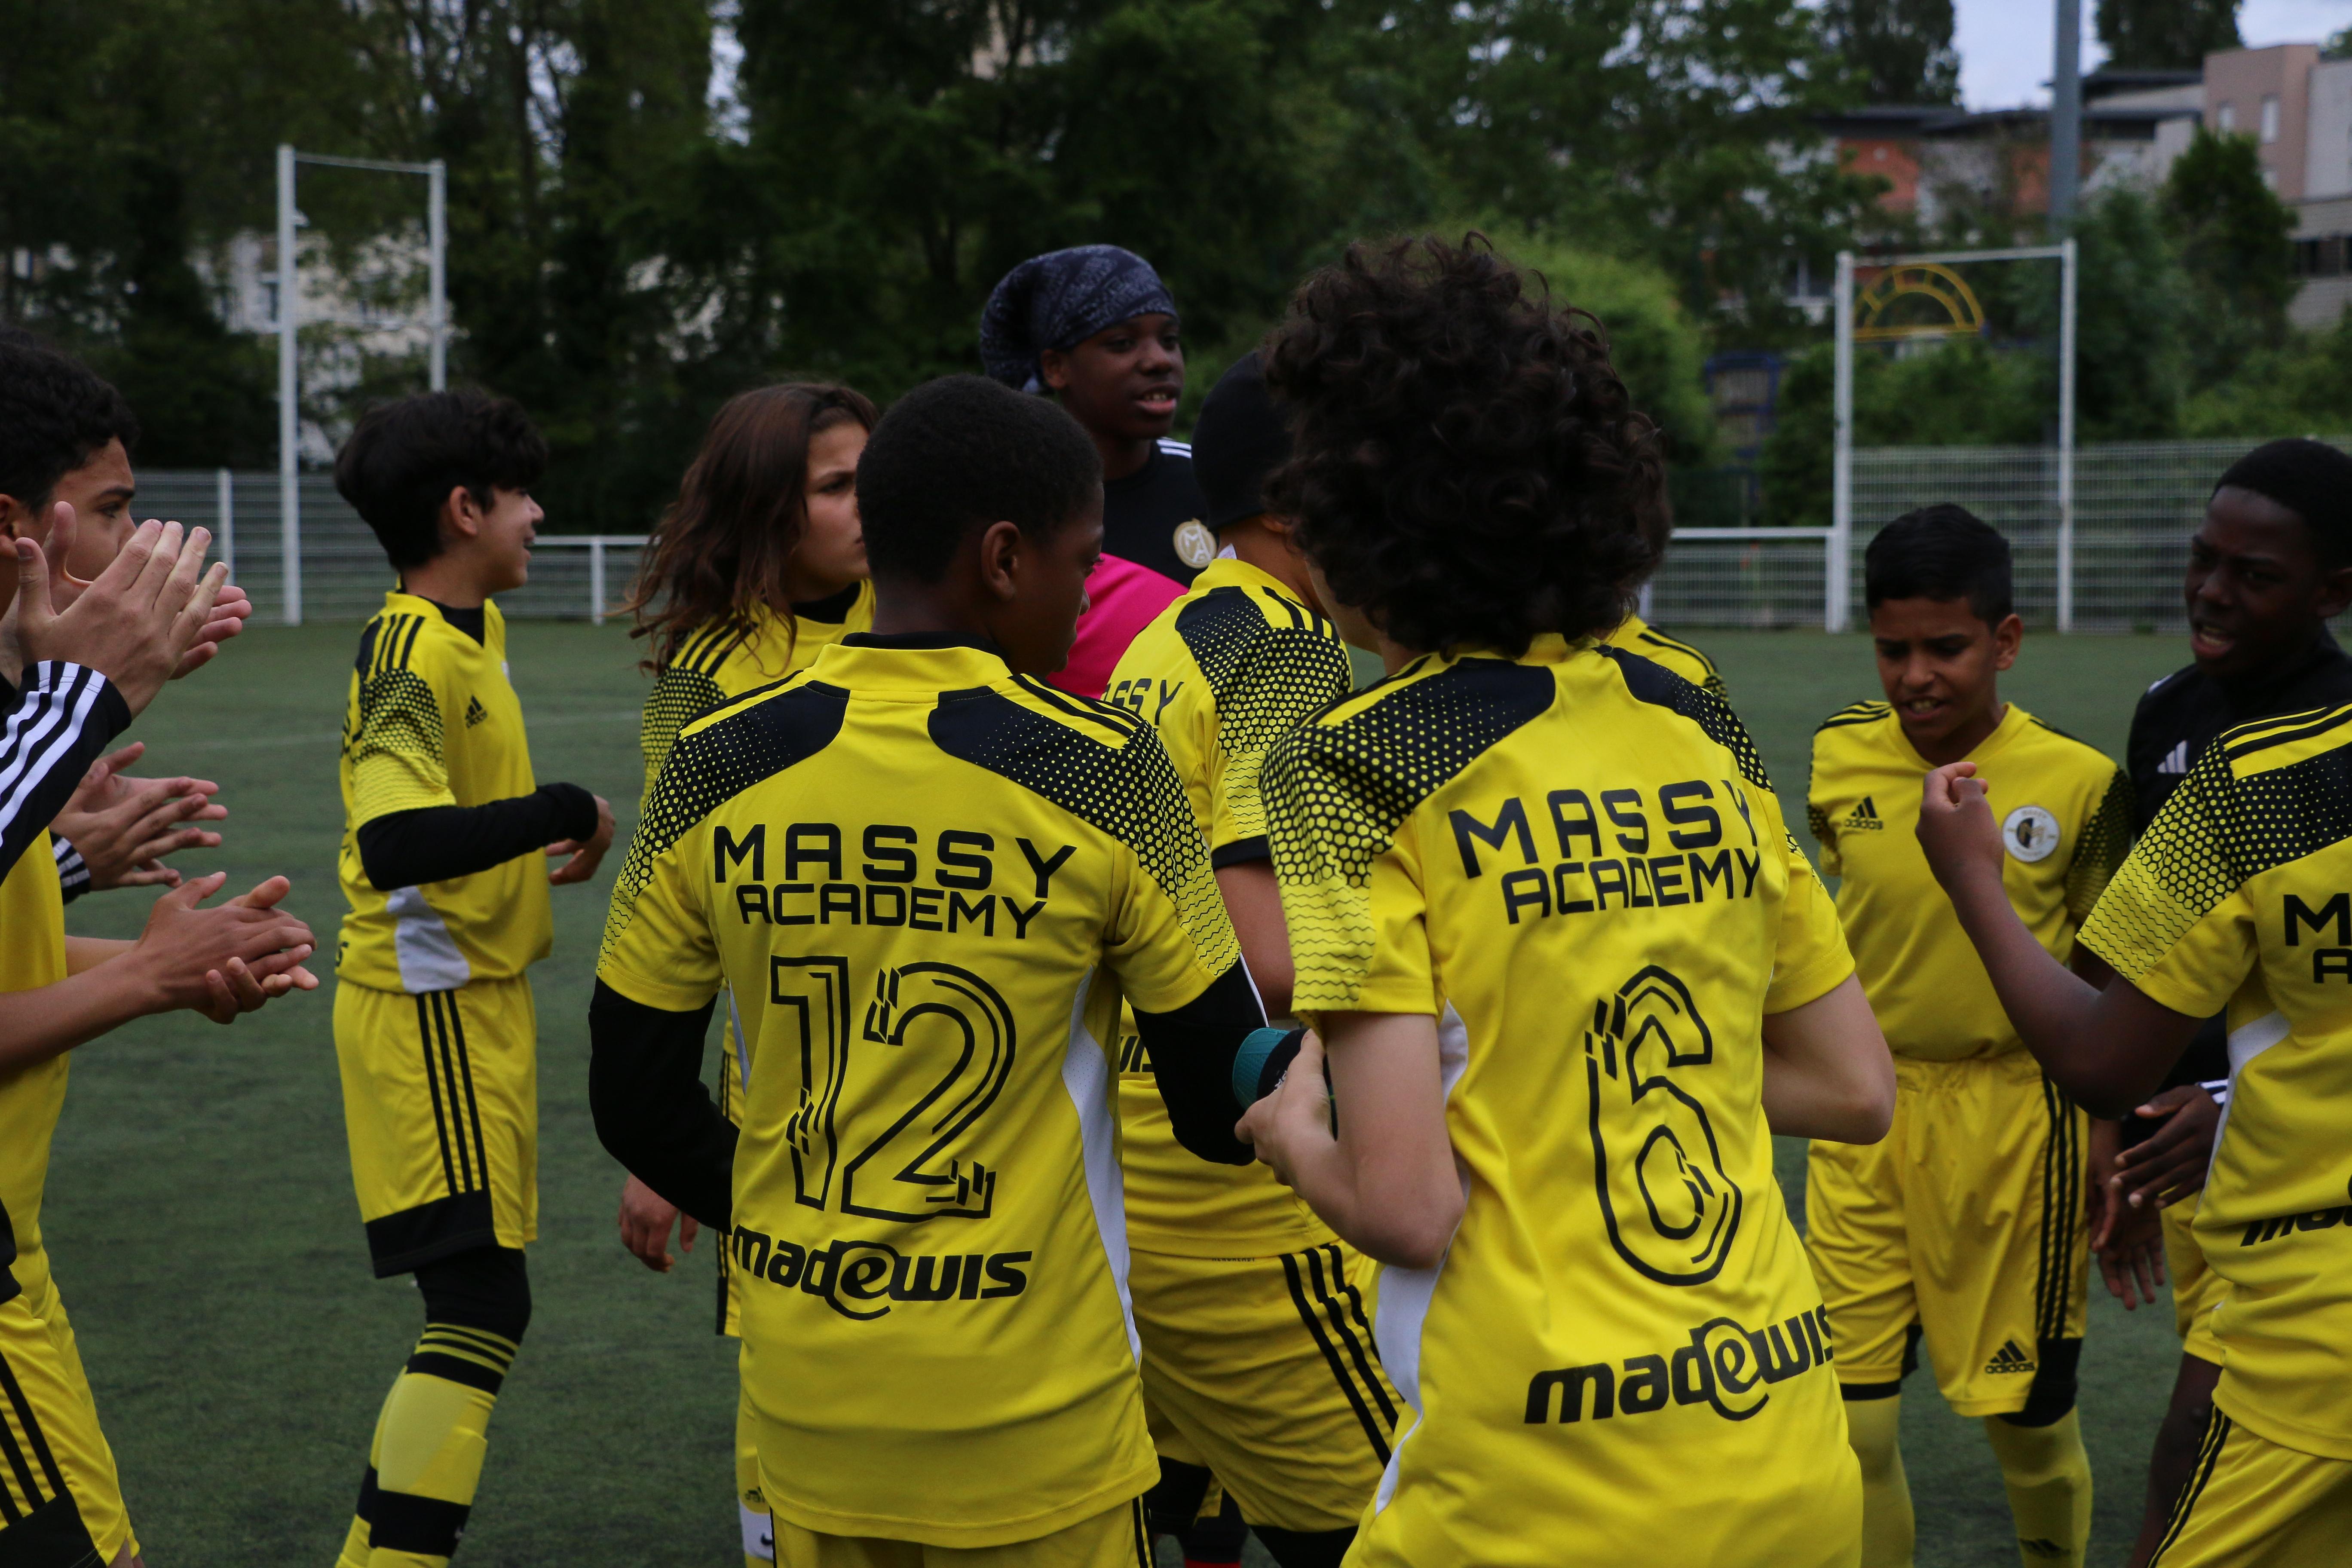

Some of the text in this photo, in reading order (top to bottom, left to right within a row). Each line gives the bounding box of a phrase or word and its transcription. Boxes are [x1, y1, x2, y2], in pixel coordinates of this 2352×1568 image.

[714, 823, 1076, 898] MASSY
[1449, 780, 1758, 879] MASSY
[1844, 817, 1883, 830] adidas
[736, 884, 1046, 939] ACADEMY
[1502, 848, 1760, 924] ACADEMY
[771, 955, 1016, 1223] 12
[1585, 965, 1742, 1286] 6
[1985, 1362, 2035, 1374] adidas
